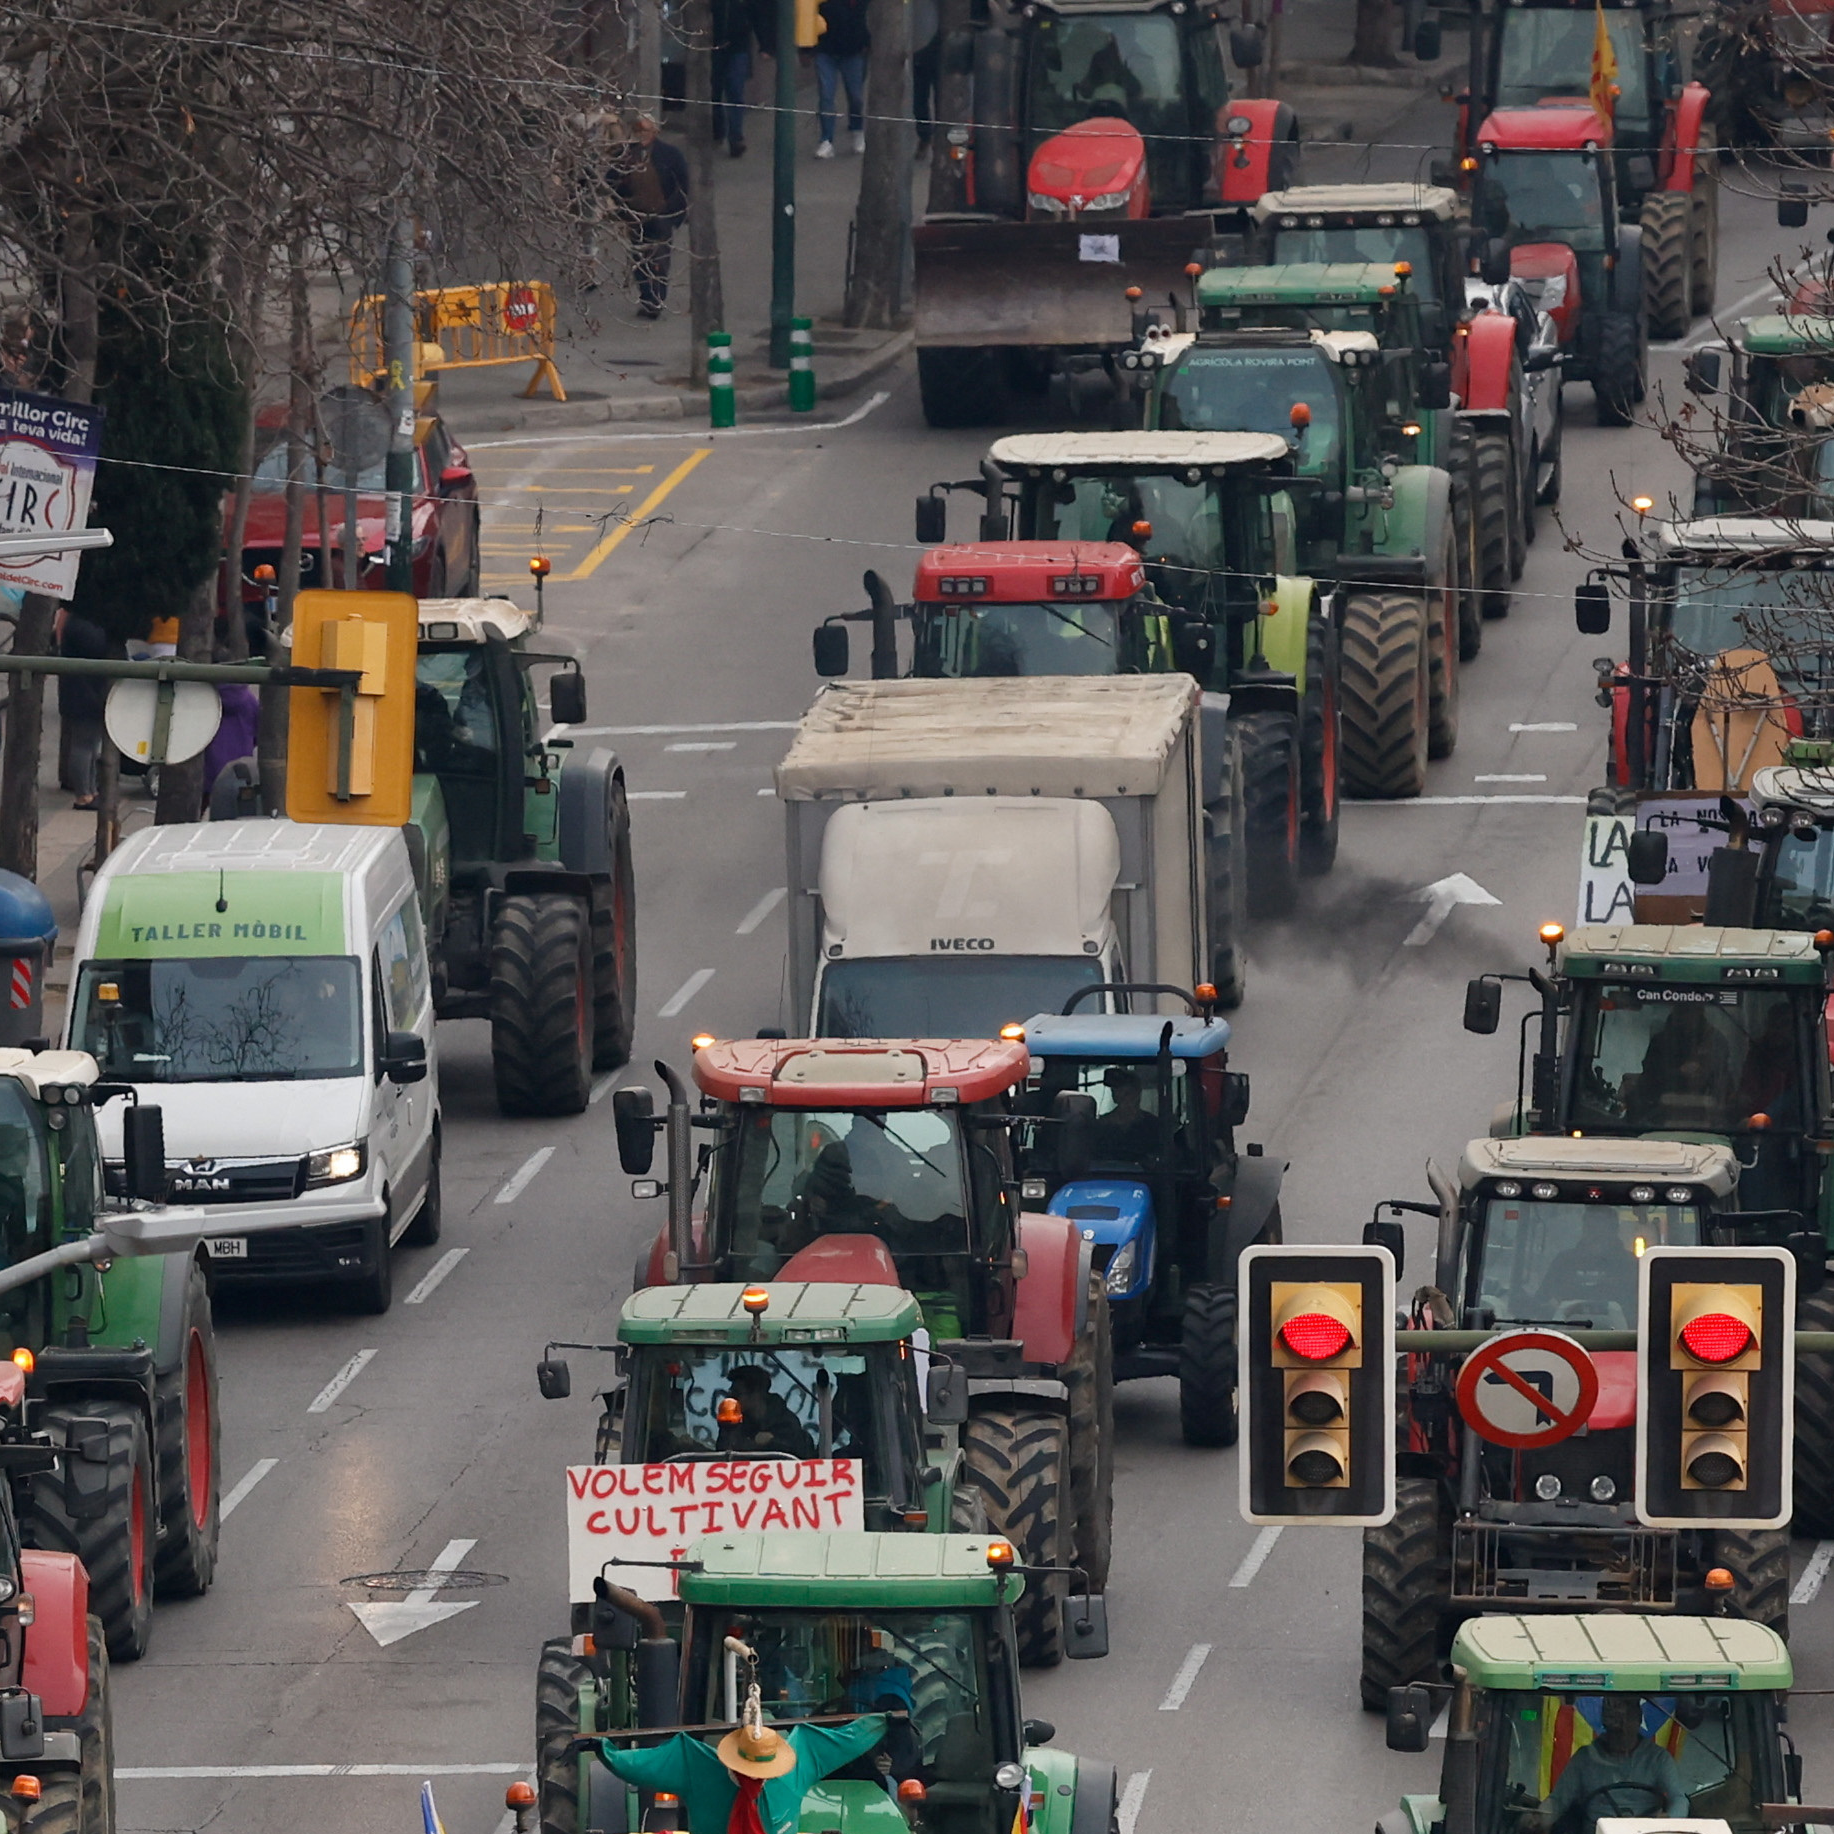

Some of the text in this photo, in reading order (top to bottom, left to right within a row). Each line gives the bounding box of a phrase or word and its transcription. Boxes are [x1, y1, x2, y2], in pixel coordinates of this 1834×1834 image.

[51, 409, 91, 432] Circ
[11, 418, 45, 438] teva
[47, 423, 88, 448] vida!
[1584, 880, 1635, 924] LA
[131, 919, 308, 944] TALLER MÒBIL
[928, 936, 996, 951] IVECO
[1637, 989, 1661, 1001] Can
[174, 1177, 231, 1192] MAN
[213, 1240, 242, 1256] MBH
[567, 1458, 857, 1500] VOLEM SEGUIR
[586, 1490, 853, 1537] CULTIVANT
